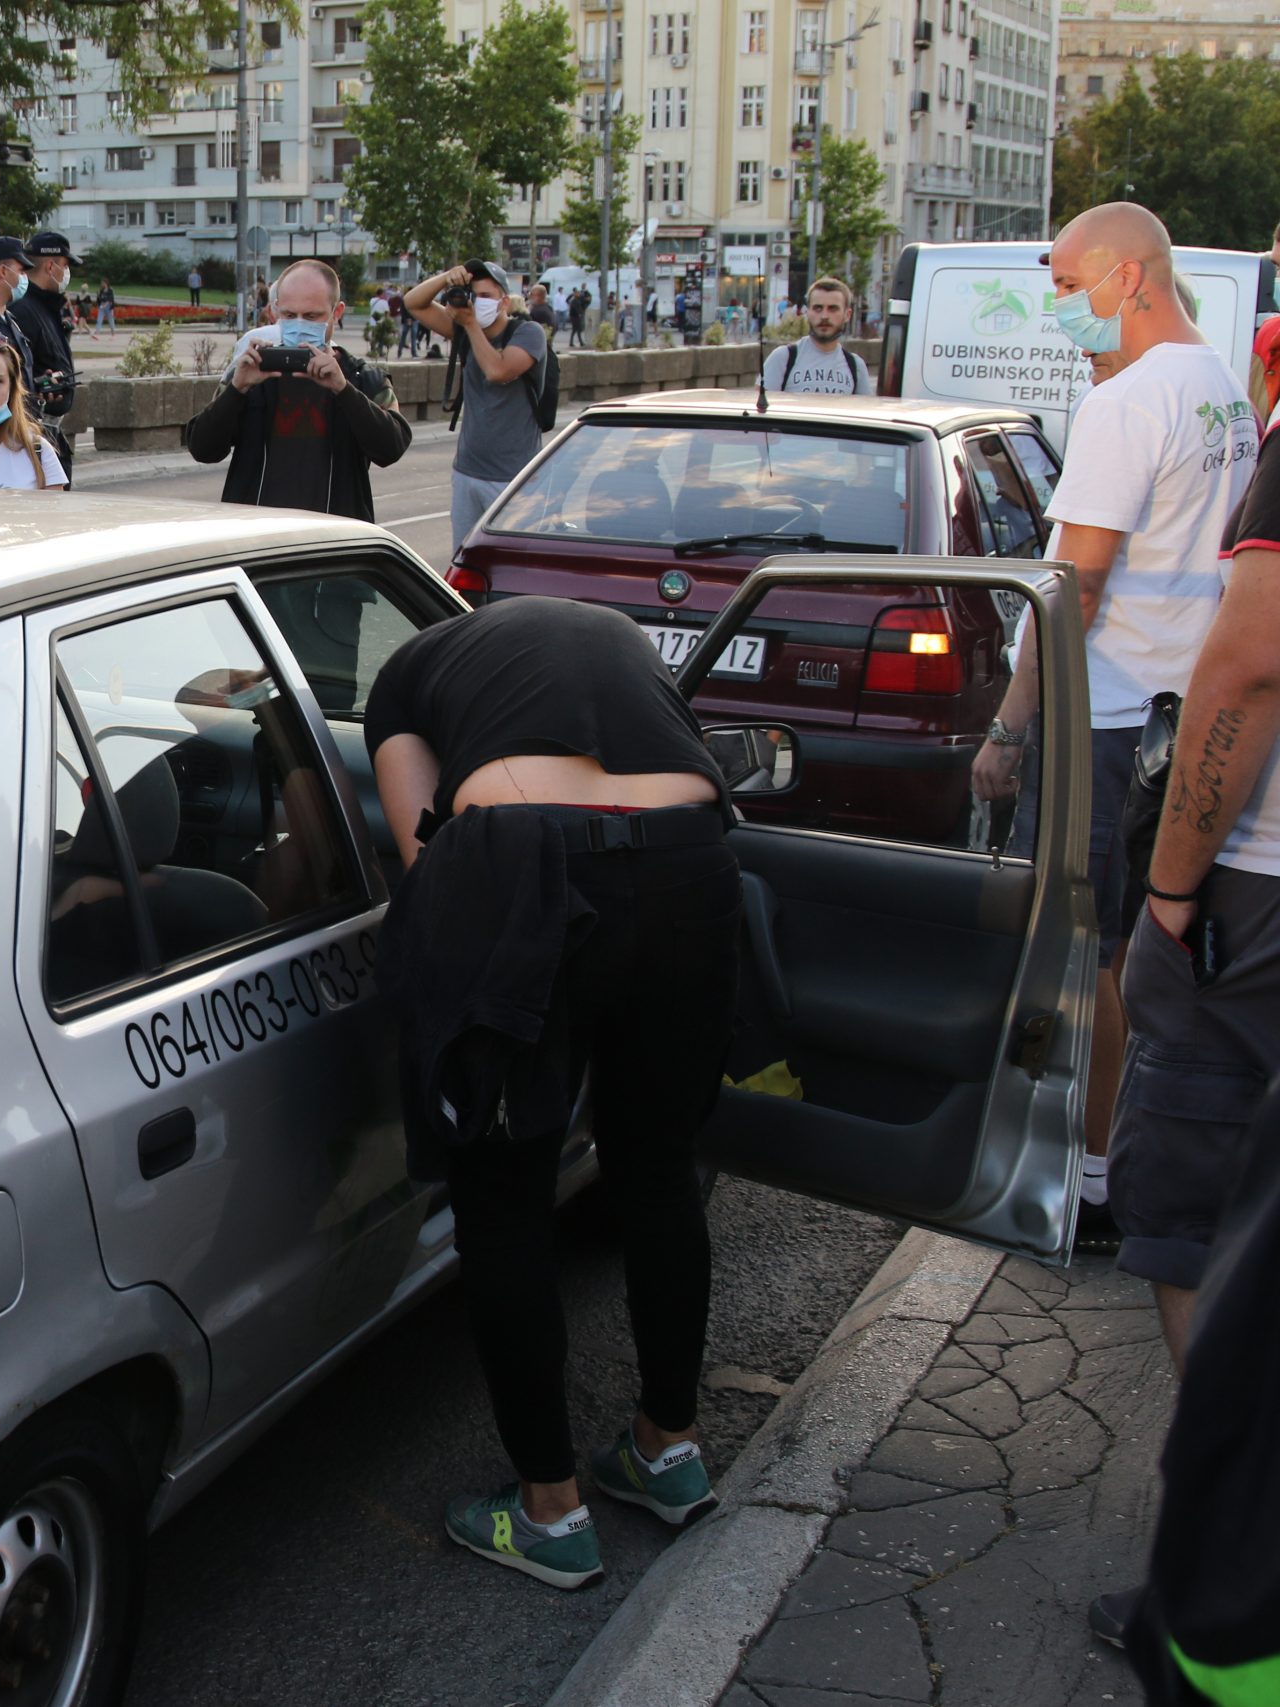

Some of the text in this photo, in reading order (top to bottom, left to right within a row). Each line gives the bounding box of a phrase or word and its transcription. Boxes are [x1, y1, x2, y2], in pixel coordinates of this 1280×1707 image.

[932, 344, 1024, 360] DUBINSKO
[951, 364, 1044, 381] DUBINSKO
[1009, 386, 1060, 401] TEPIH
